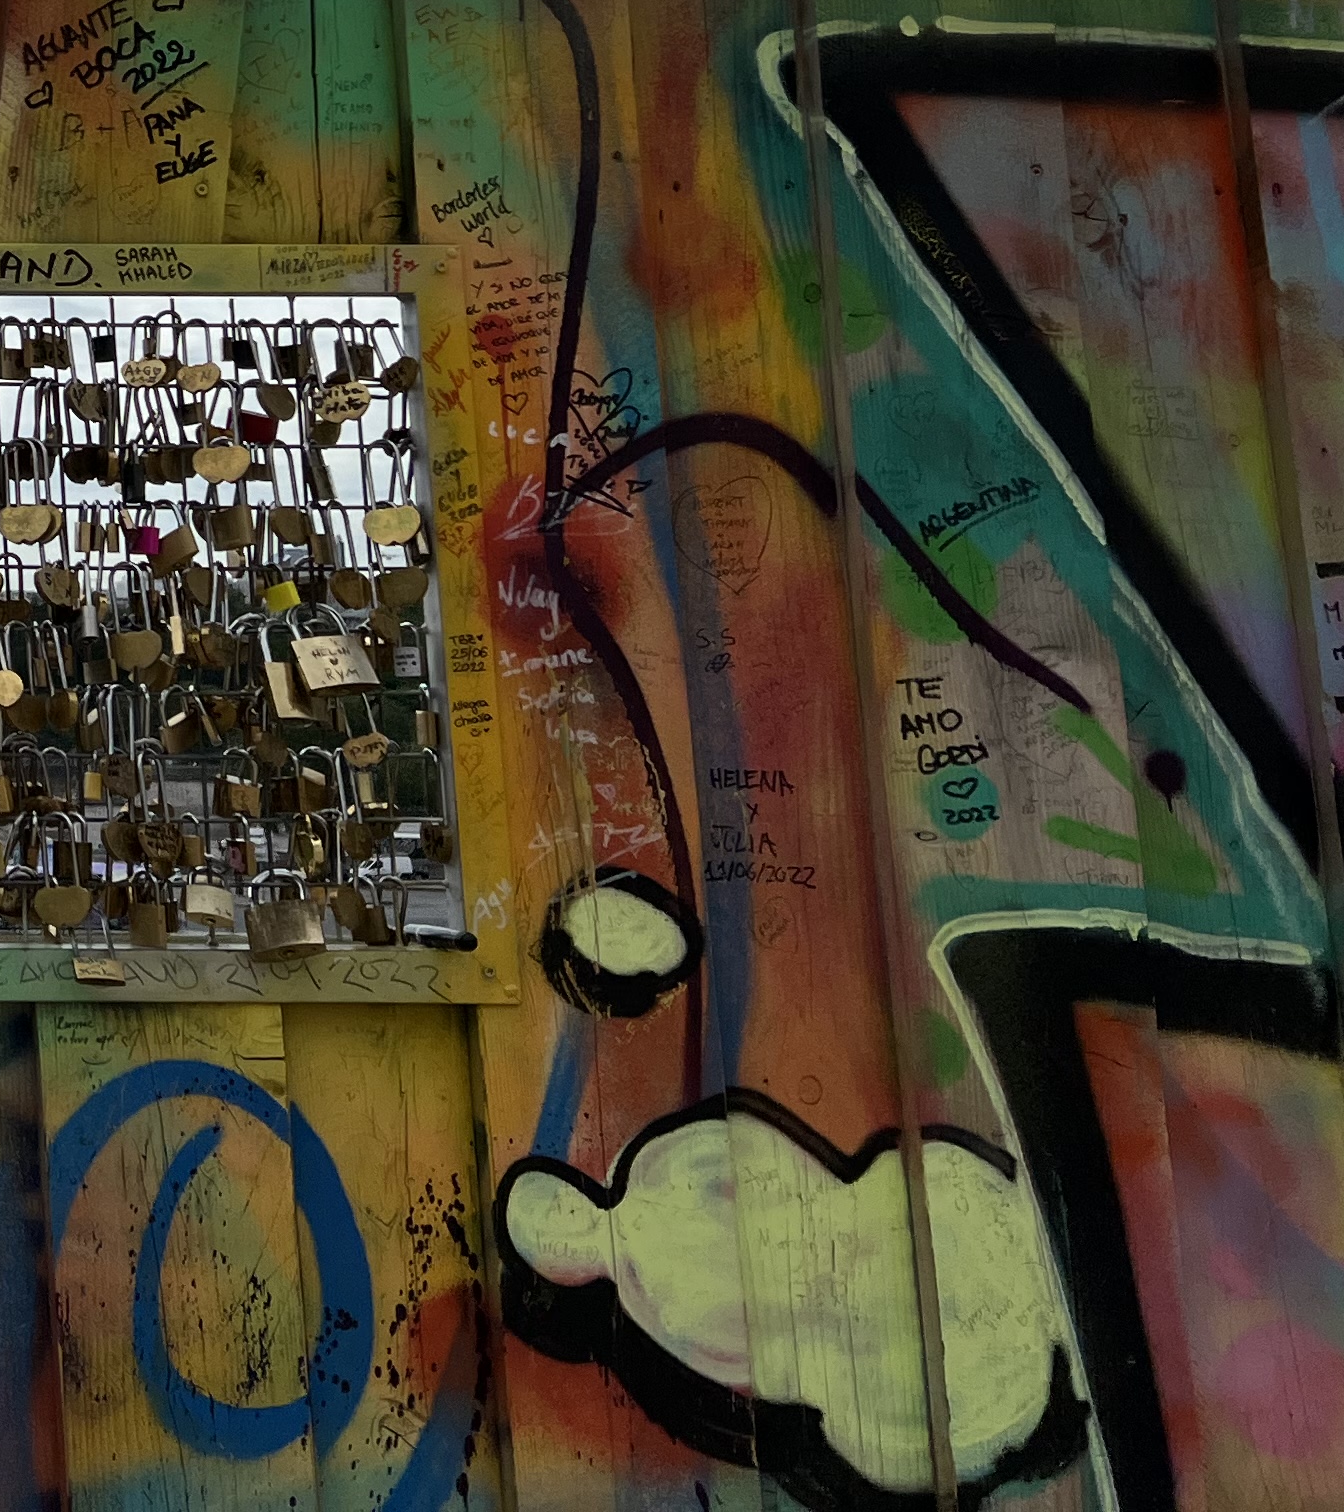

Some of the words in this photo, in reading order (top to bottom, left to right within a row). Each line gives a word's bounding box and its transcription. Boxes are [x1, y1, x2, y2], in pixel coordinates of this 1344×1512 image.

[70, 21, 157, 90] BOCA
[121, 40, 195, 94] 2022
[114, 246, 179, 267] SARAH
[118, 261, 194, 286] KHALED
[916, 476, 1042, 549] ARGENTINA
[450, 645, 489, 662] 25/06
[452, 660, 488, 673] 2022
[895, 677, 944, 705] TE
[900, 708, 963, 741] AMO
[710, 768, 797, 796] HELENA
[942, 805, 1001, 826] 2022
